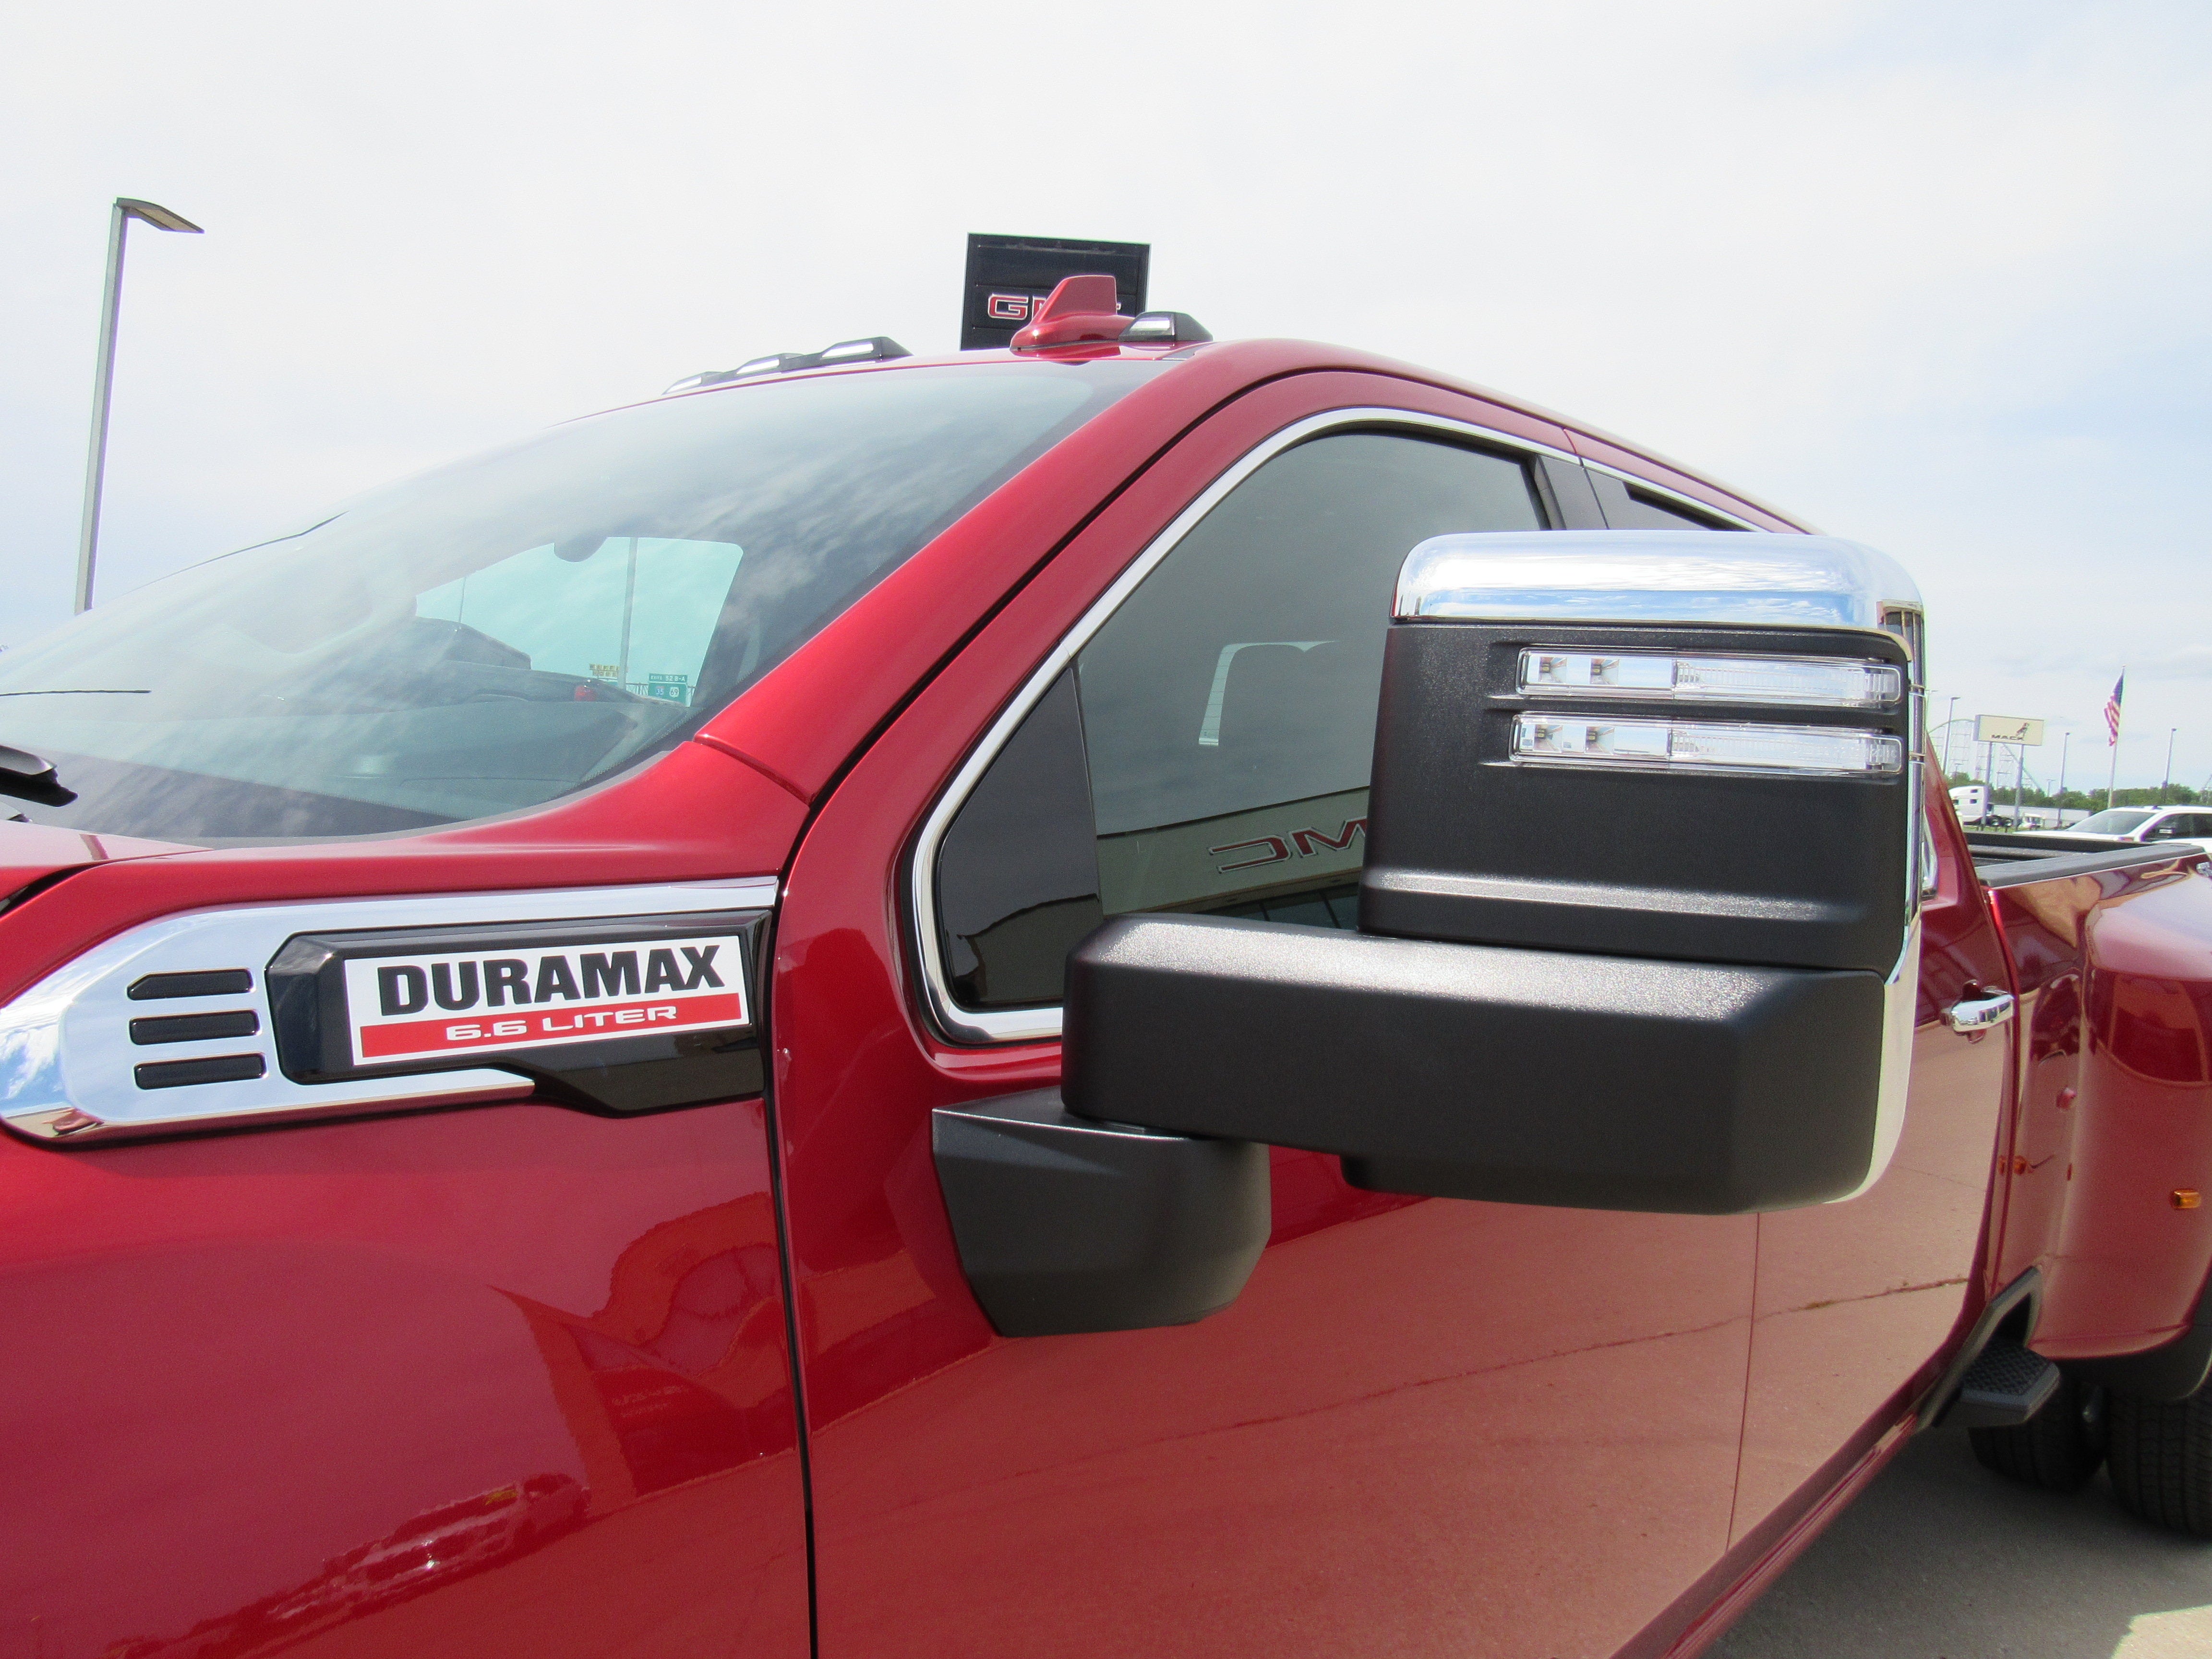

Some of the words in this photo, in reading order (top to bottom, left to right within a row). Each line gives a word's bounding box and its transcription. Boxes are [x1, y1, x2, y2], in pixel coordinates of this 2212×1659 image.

[378, 945, 725, 1016] DURAMAX
[446, 1020, 527, 1041] 6.6
[542, 1005, 677, 1032] LITER
